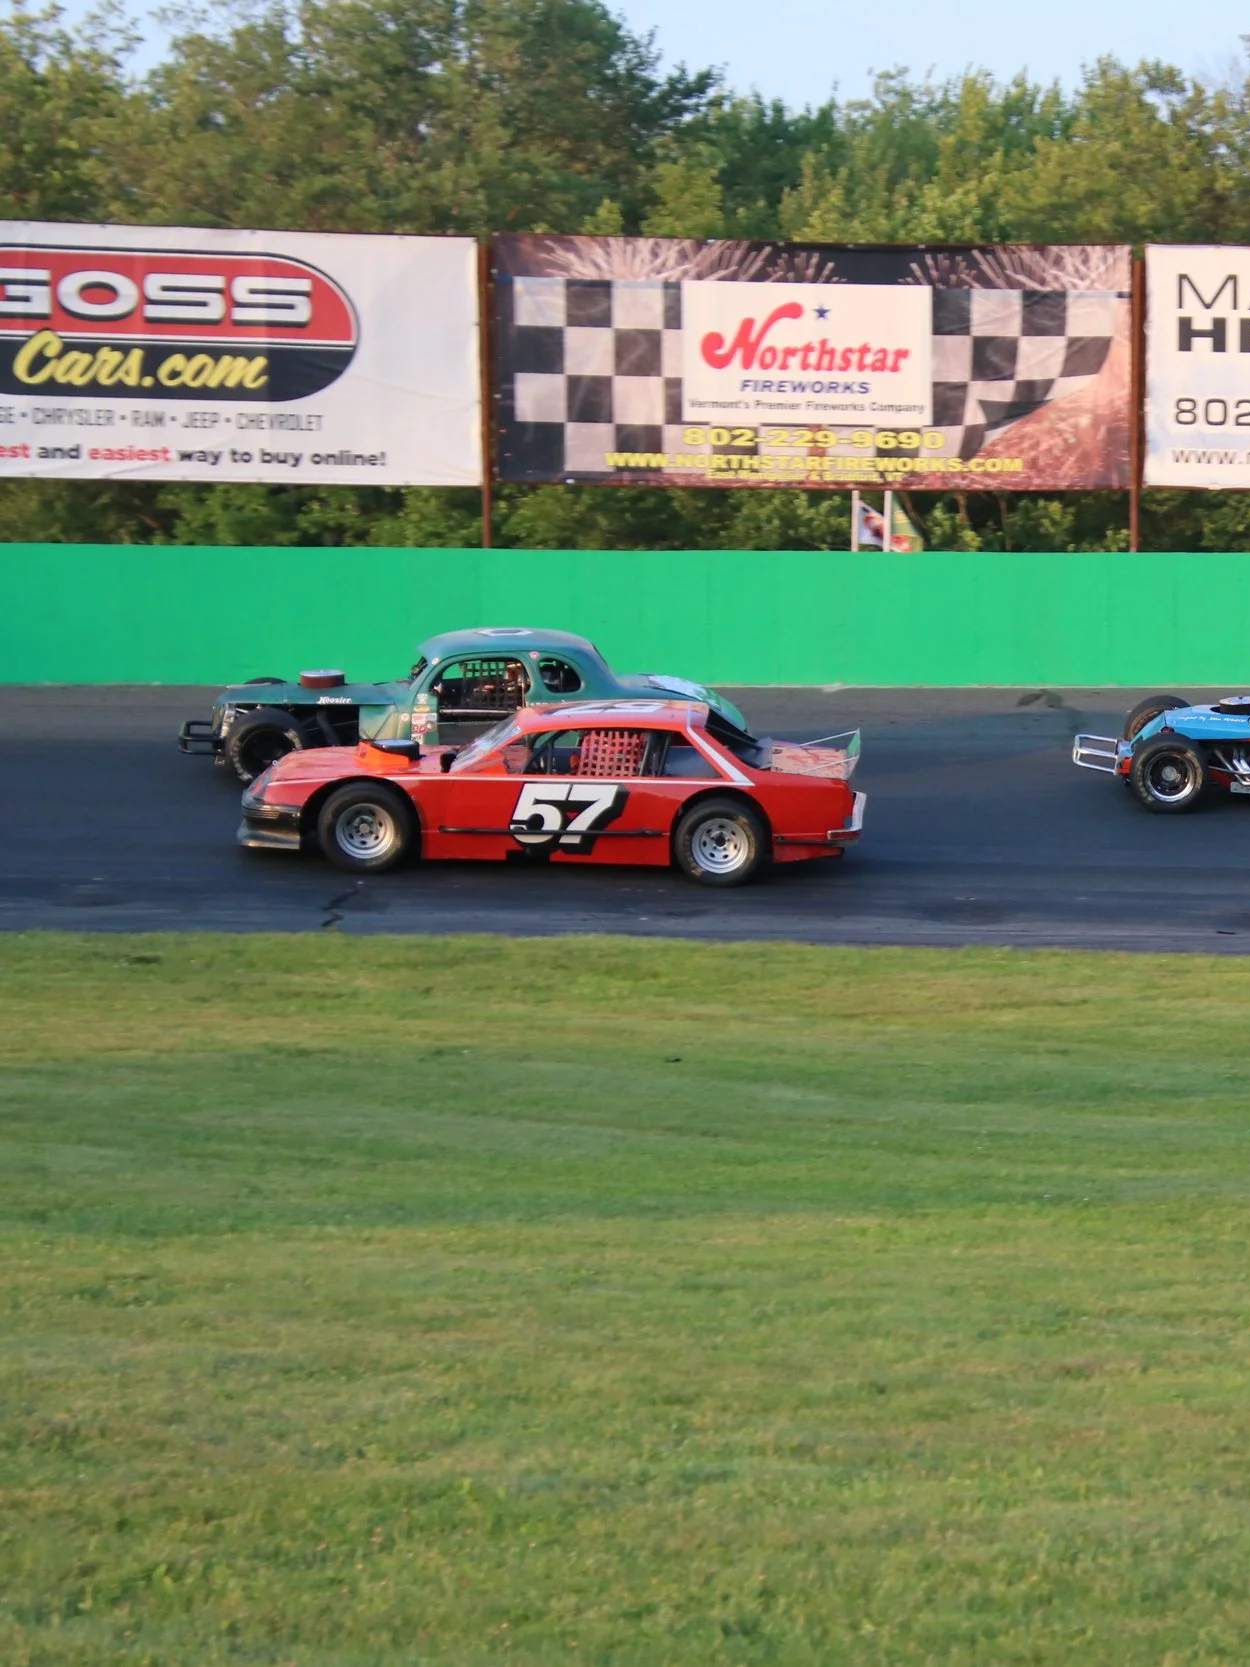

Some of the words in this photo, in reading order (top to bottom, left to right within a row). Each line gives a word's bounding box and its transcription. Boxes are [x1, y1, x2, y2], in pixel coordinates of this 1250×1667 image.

[0, 268, 313, 326] GOSS
[700, 301, 910, 373] Northstar
[13, 328, 269, 390] Cars.com
[740, 379, 871, 394] FIREWORKS
[689, 399, 750, 410] Vermont's
[755, 399, 801, 410] Premier
[805, 400, 865, 412] Fireworks
[869, 401, 925, 414] Company
[32, 407, 115, 425] CHRYSLER
[131, 409, 166, 427] RAM
[181, 411, 221, 429] JEEP
[235, 412, 324, 432] CHEVROLET
[682, 427, 945, 449] 802-229-9690
[38, 444, 82, 459] and
[88, 444, 171, 462] easiest
[176, 449, 222, 466] way
[230, 447, 253, 464] to
[260, 448, 303, 467] buy
[310, 450, 387, 466] online!
[605, 452, 1024, 473] WWW.NORTHSTARFIREWORKS.COM
[316, 695, 353, 706] Hoosier
[509, 782, 625, 848] 57
